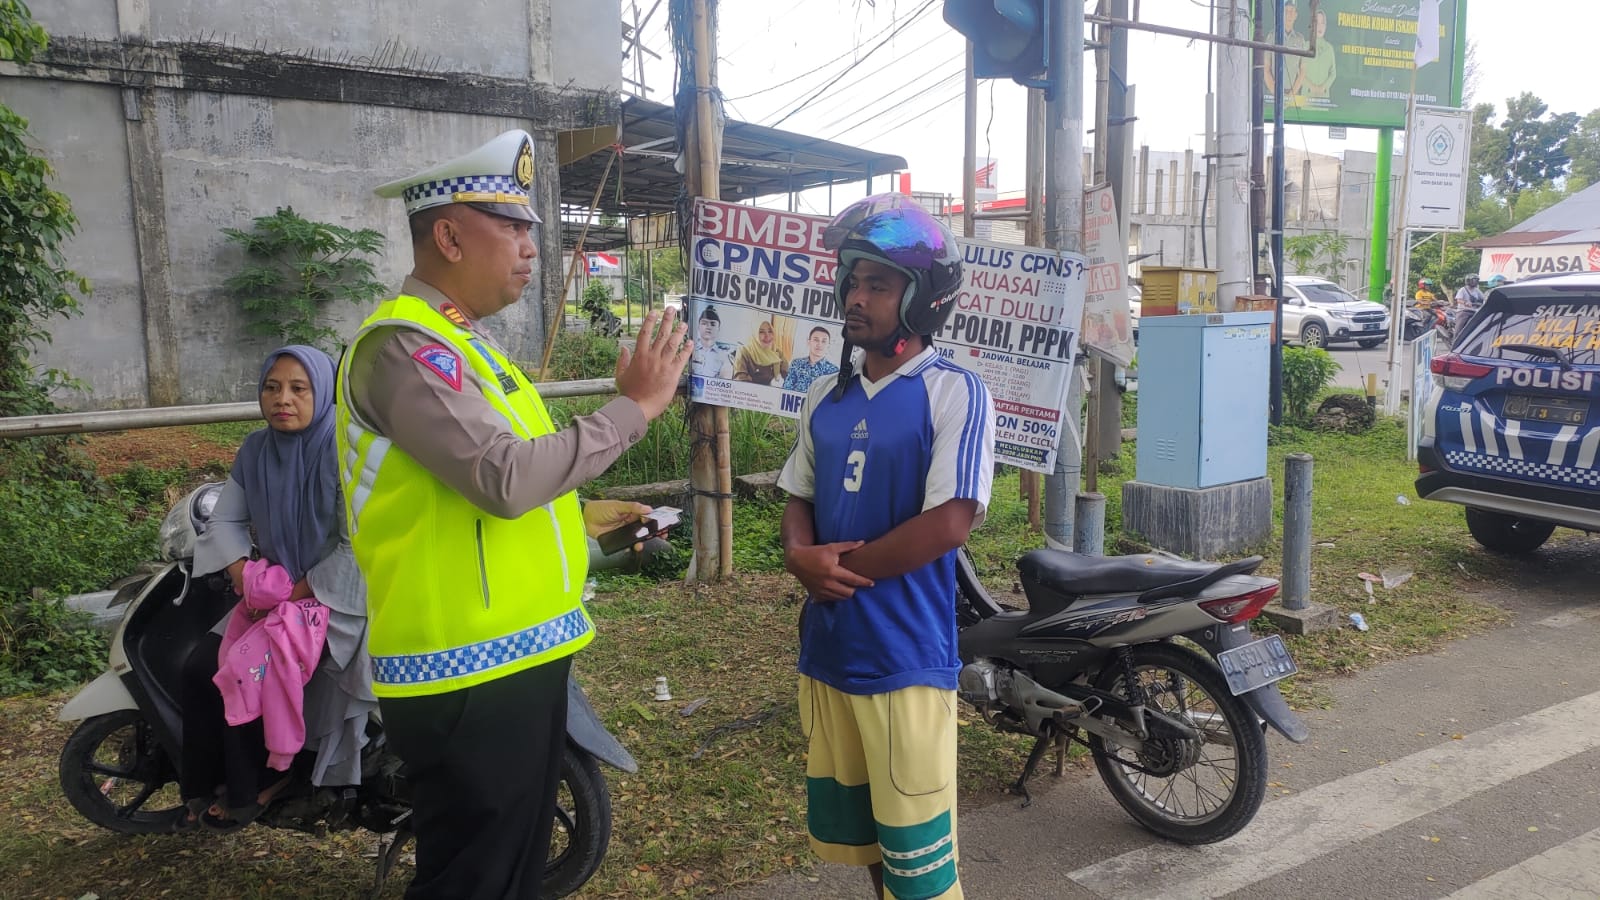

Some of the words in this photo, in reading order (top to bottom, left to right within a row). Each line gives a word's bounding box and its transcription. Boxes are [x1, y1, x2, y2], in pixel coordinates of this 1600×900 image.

[694, 237, 810, 283] CPNS
[1515, 254, 1584, 273] YUASA
[970, 270, 1041, 297] KUASAI
[1535, 319, 1576, 333] KILA
[1018, 324, 1074, 360] PPPK
[1492, 334, 1525, 348] AYO
[1527, 333, 1583, 349] PAKAI
[981, 351, 1014, 364] JADWAL
[1016, 358, 1051, 370] BELAJAR
[706, 379, 732, 390] LOKASI
[1496, 366, 1593, 392] POLISI
[1020, 406, 1056, 419] PERTAMA
[1018, 434, 1028, 442] DI
[1021, 420, 1057, 438] 50%
[843, 450, 866, 493] 3
